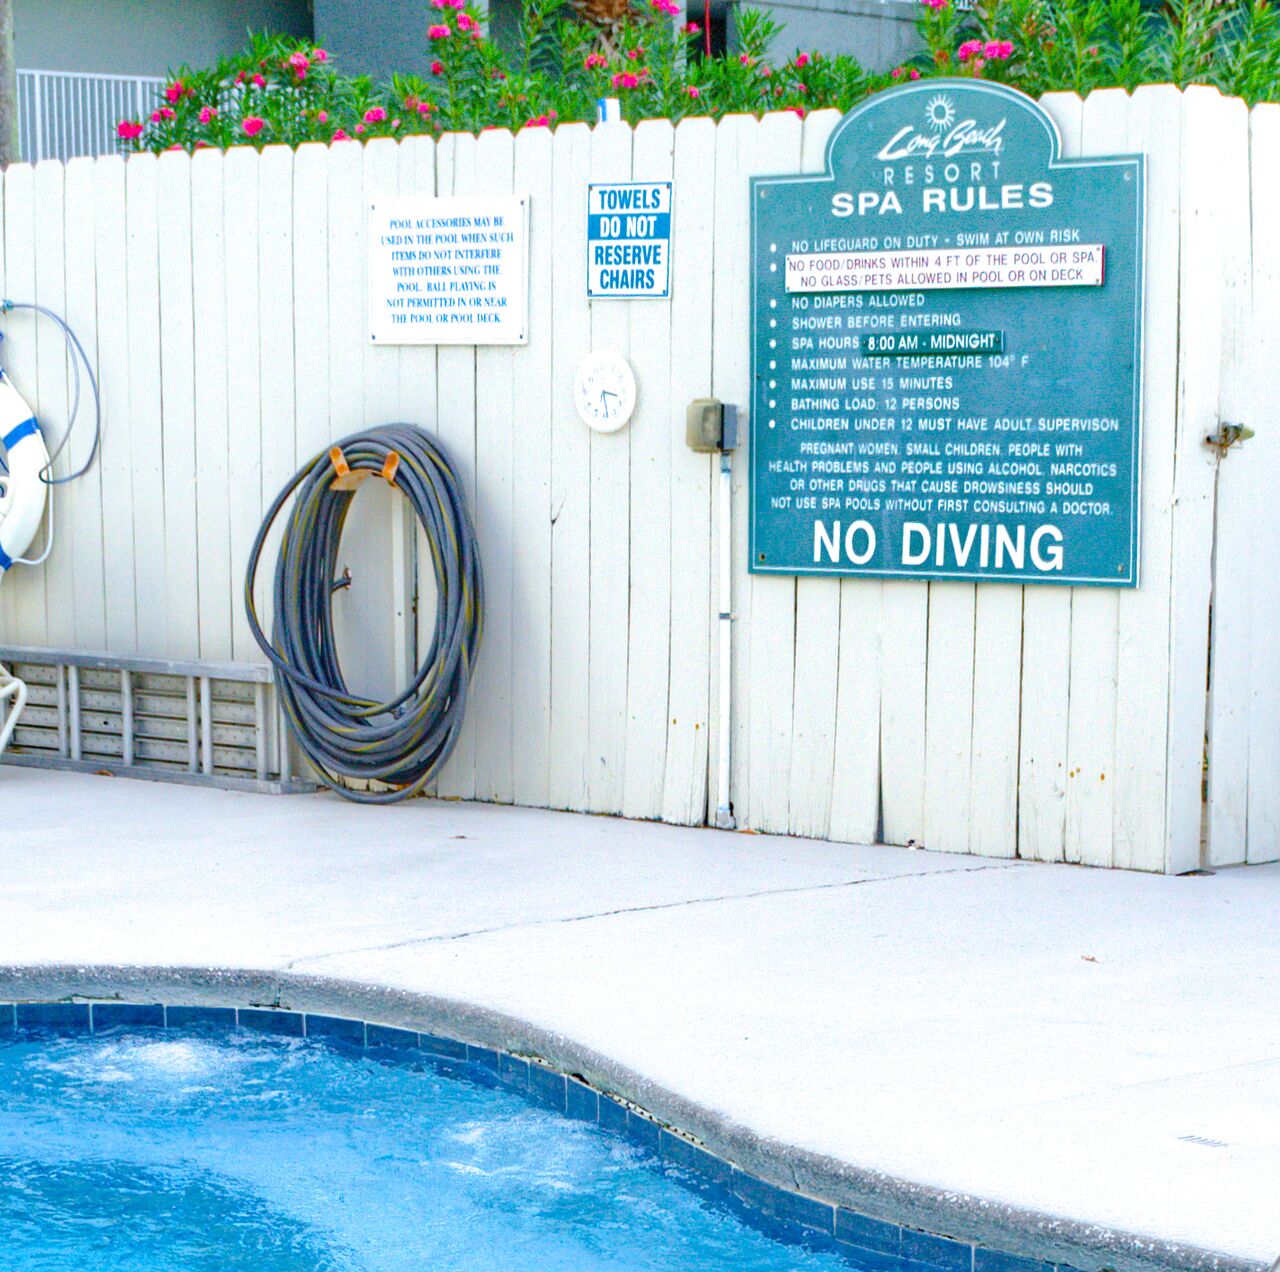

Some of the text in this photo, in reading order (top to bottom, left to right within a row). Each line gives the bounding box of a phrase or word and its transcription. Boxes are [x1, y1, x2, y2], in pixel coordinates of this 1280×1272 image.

[876, 118, 1006, 160] Long Beach
[884, 162, 999, 185] RESORT
[598, 189, 661, 210] TOWELS
[831, 183, 1053, 217] SPA RULES
[390, 216, 504, 230] POOL ACCESSORIES MAY BE
[600, 216, 657, 238] DO NOT
[381, 232, 514, 245] USED IN THE POOL WHEN SUCH
[792, 240, 808, 252] NO
[815, 238, 878, 251] LIFEGUARD
[884, 237, 900, 249] ON
[907, 235, 938, 248] DUTY
[956, 232, 989, 246] SWIM
[995, 232, 1009, 245] AT
[1015, 231, 1043, 244] OWN
[1051, 229, 1080, 242] RISK
[392, 249, 501, 261] ITEMS DO NOT INTERFERE
[594, 244, 662, 266] RESERVE
[789, 251, 1098, 272] NO FOOD/DRINKS WITHIN 4 FT OF THE POOL OR SPA.
[393, 265, 501, 276] WITH OTHERS USING THE
[801, 269, 1083, 287] NO GLASS/PETS ALLOWED IN POOL OR ON DECK
[427, 281, 447, 292] BALL
[450, 281, 486, 291] PLAYING
[488, 281, 496, 291] IS
[599, 268, 655, 290] CHAIRS
[387, 297, 507, 308] NOT PERMITTED IN OR NEAR
[792, 294, 925, 309] NO DIAPERS ALLOWED
[392, 314, 407, 323] THE
[410, 313, 433, 323] POOL
[436, 313, 448, 323] OR
[451, 313, 473, 323] POOL
[792, 313, 961, 329] SHOWER BEFORE ENTERING
[792, 338, 813, 349] SPA
[868, 335, 895, 350] 8:00
[898, 335, 918, 349] AM
[931, 334, 995, 349] MIDNIGHT
[791, 358, 847, 370] MAXIMUM
[852, 357, 890, 369] WATER
[896, 356, 982, 369] TEMPERATURE
[1021, 355, 1029, 368] F
[791, 377, 953, 390] MAXIMUM USE 15 MINUTES
[791, 398, 839, 410] BATHING
[886, 398, 896, 410] 12
[902, 398, 960, 410] PERSONS
[791, 418, 849, 431] CHILDREN
[855, 418, 895, 431] UNDER
[901, 418, 912, 430] 12
[918, 418, 952, 431] MUST
[958, 418, 988, 431] HAVE
[994, 418, 1032, 431] ADULT
[800, 442, 854, 455] PREGNANT
[906, 443, 940, 456] SMALL
[1008, 444, 1050, 457] PEOPLE
[1055, 444, 1083, 457] WITH
[769, 460, 807, 473] HEALTH
[812, 461, 869, 473] PROBLEMS
[874, 462, 896, 474] AND
[901, 462, 942, 474] PEOPLE
[948, 462, 983, 475] USING
[1050, 463, 1117, 477] NARCOTICS
[790, 479, 1093, 495] OR OTHER DRUGS THAT CAUSE DROWSINESS SHOULD
[771, 497, 792, 509] NOT
[796, 497, 816, 509] USE
[822, 498, 841, 510] SPA
[845, 498, 881, 510] POOLS
[885, 498, 933, 511] WITHOUT
[938, 499, 968, 512] FIRST
[974, 500, 1045, 514] CONSULTING
[1050, 502, 1058, 514] A
[813, 520, 1064, 571] NO DIVING
